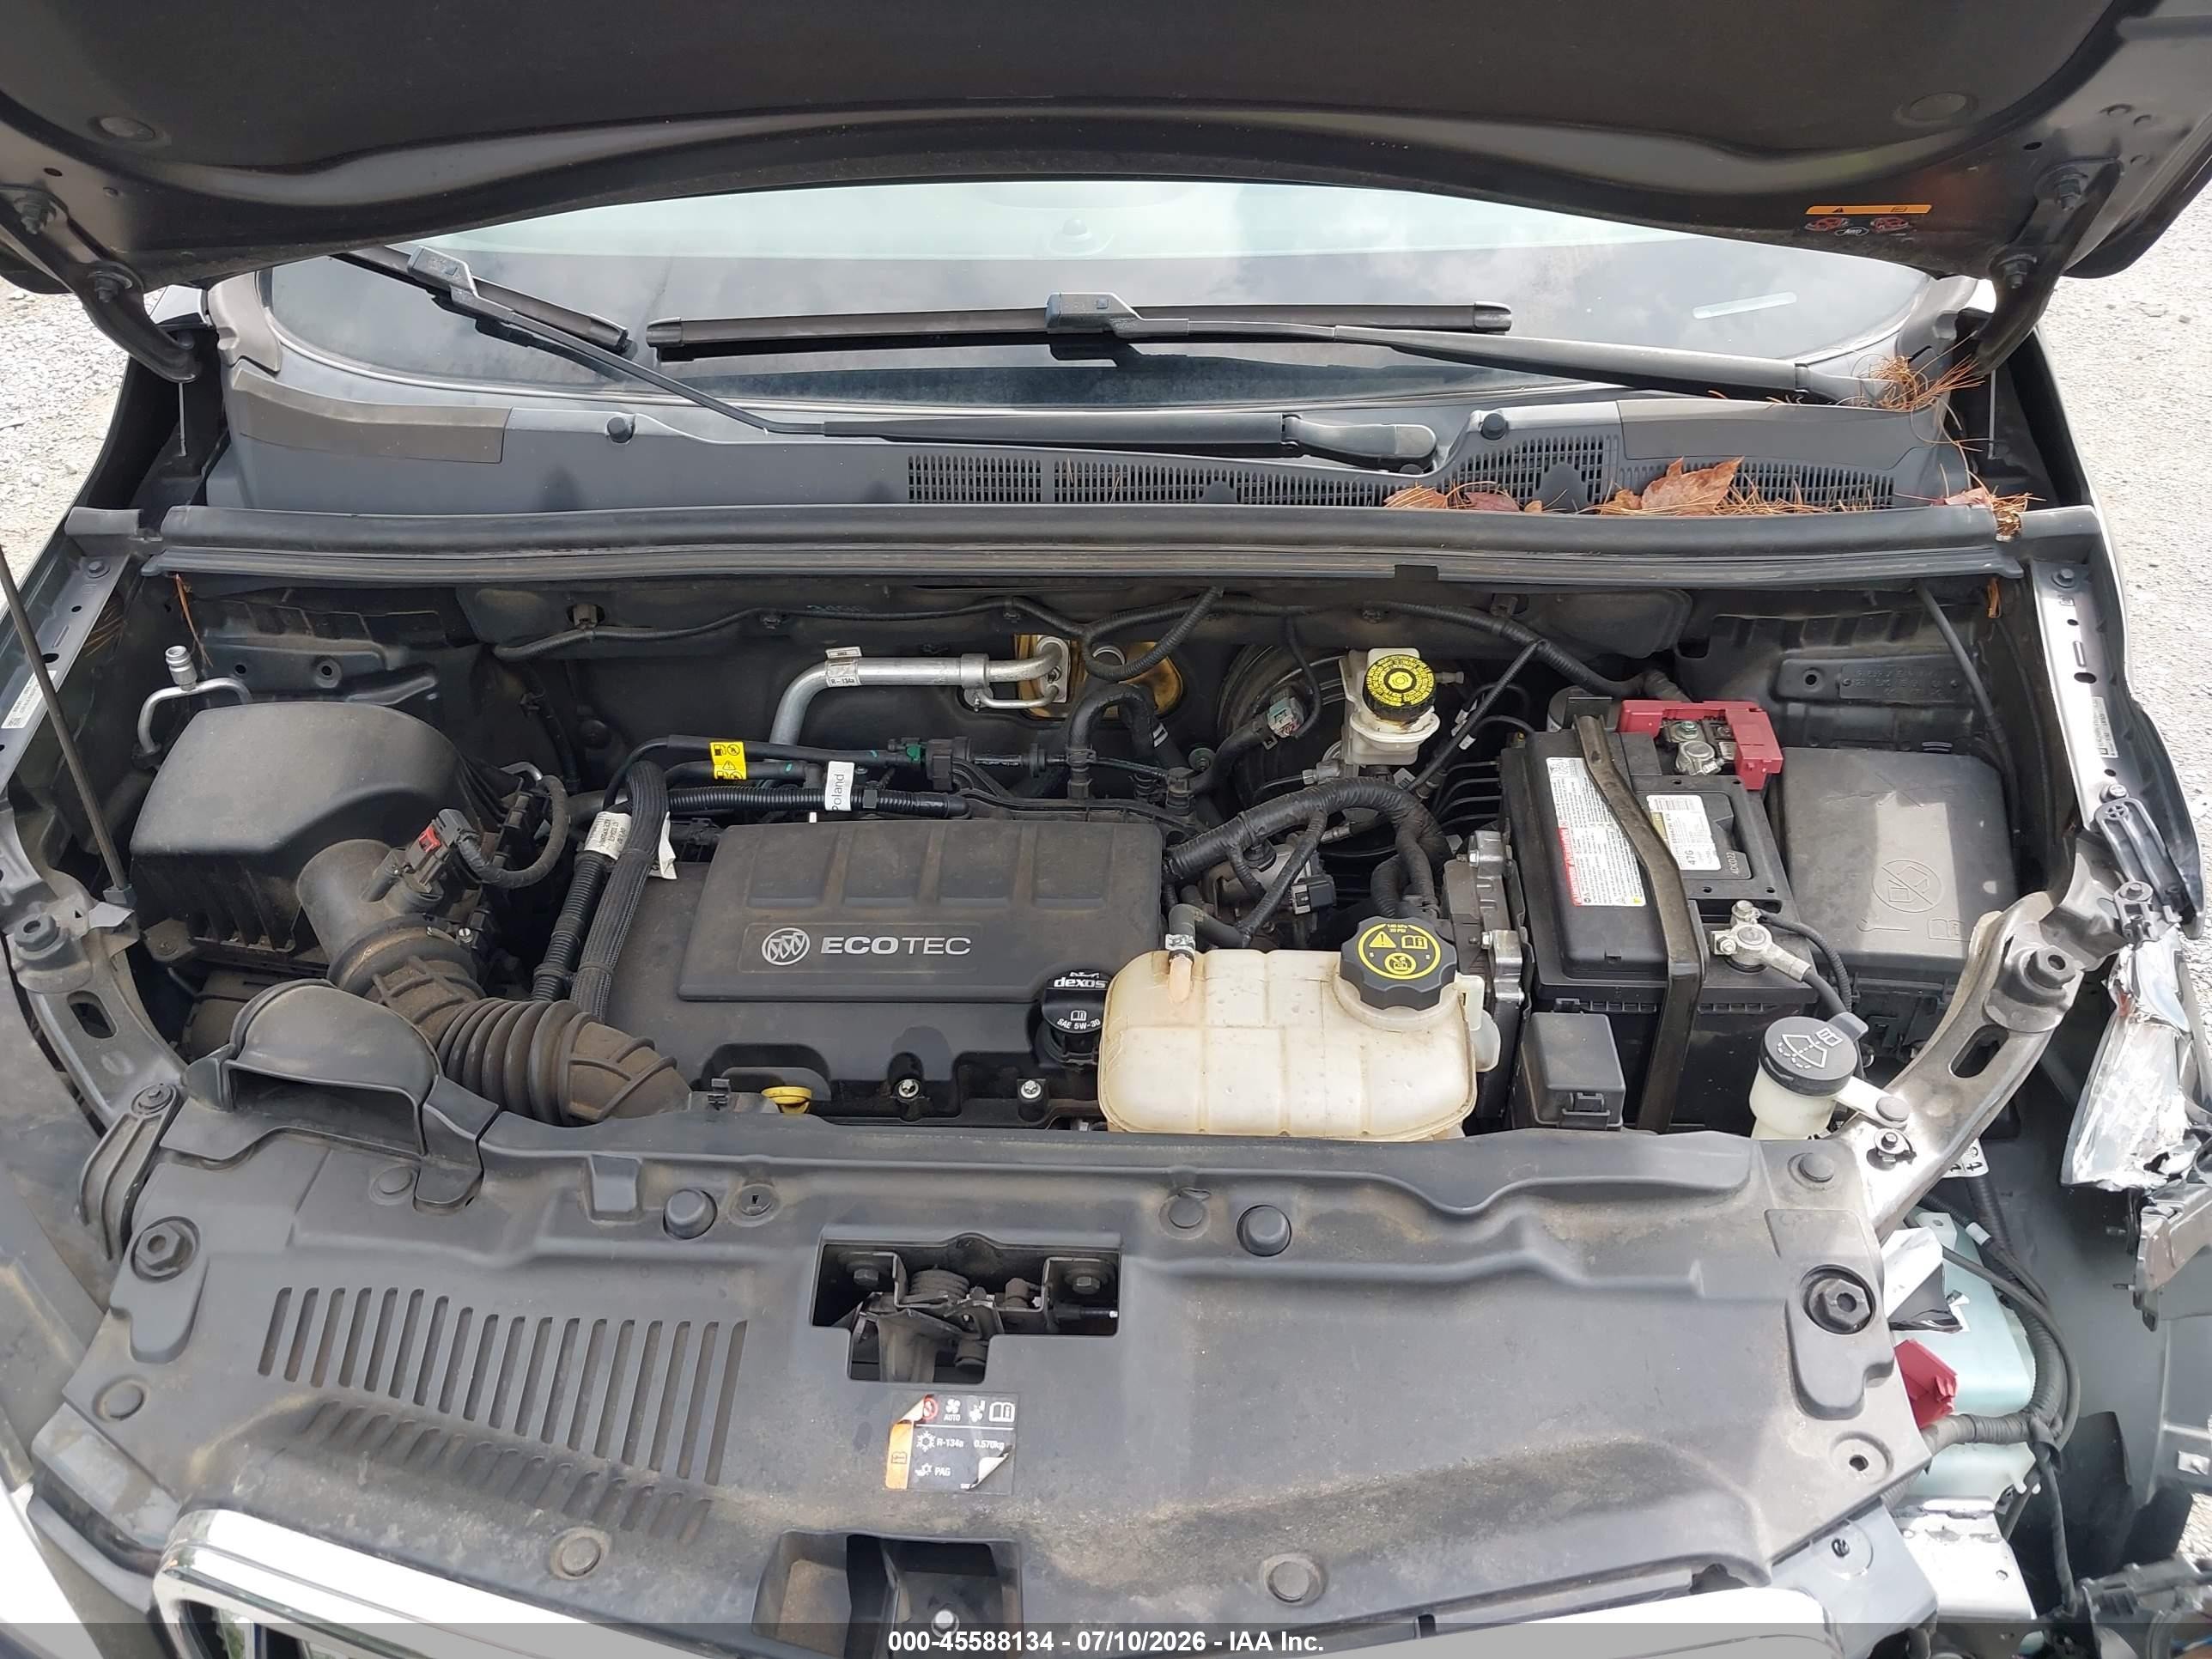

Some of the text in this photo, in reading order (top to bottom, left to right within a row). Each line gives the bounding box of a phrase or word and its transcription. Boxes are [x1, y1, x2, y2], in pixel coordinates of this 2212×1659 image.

[1685, 849, 1696, 865] 47G
[821, 936, 972, 955] ECOTEC
[1054, 976, 1108, 988] dexos
[1057, 1018, 1101, 1030] SAE 5W-30
[936, 1438, 964, 1448] R-134a
[934, 1467, 951, 1477] PAG
